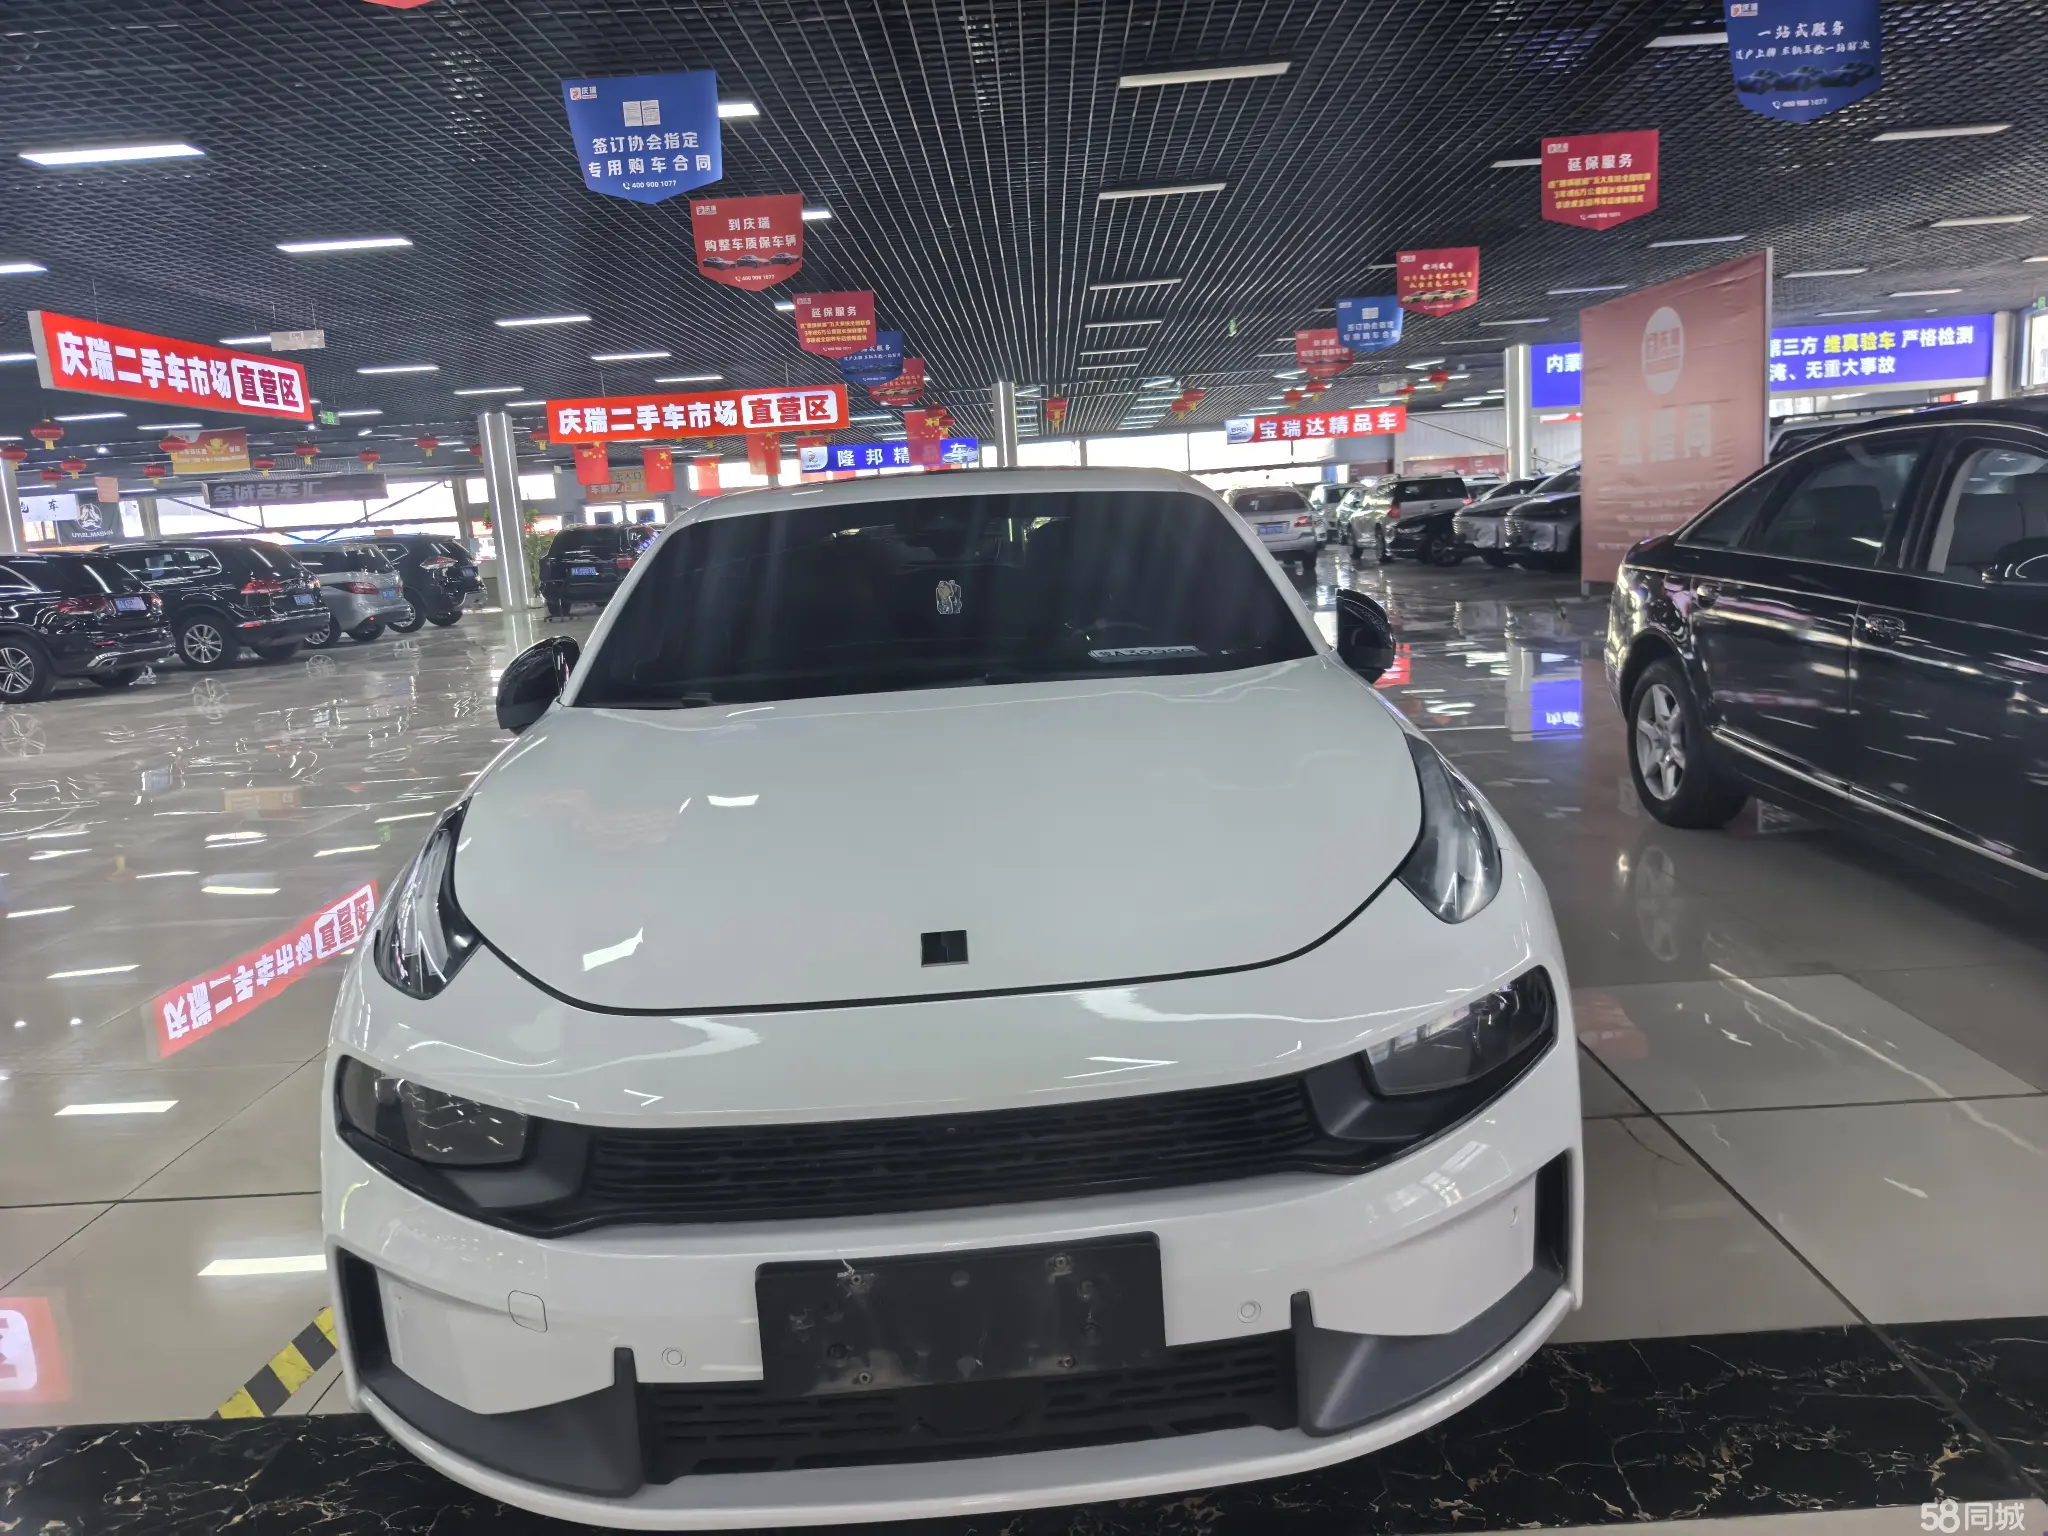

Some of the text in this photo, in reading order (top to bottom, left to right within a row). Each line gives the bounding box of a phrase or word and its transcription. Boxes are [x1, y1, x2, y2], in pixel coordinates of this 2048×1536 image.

[1757, 20, 1845, 39] 一站式服务
[592, 131, 699, 155] 签订协会指定
[588, 154, 712, 179] 专用购车合同
[1567, 153, 1633, 172] 延保服务
[632, 181, 645, 189] 400
[661, 180, 677, 188] 1077
[728, 216, 771, 231] 到庆瑞
[704, 234, 797, 252] 购整车质保车辆
[811, 305, 857, 319] 延保服务
[1823, 331, 1896, 354] 维真验车
[1901, 325, 1974, 348] 严格检测
[56, 331, 300, 408] 庆瑞二手车市场 直营区
[558, 394, 832, 436] 庆瑞二手车市场 直营区
[1259, 411, 1397, 440] 宝瑞达精品车
[213, 481, 323, 501] 金诚名车汇
